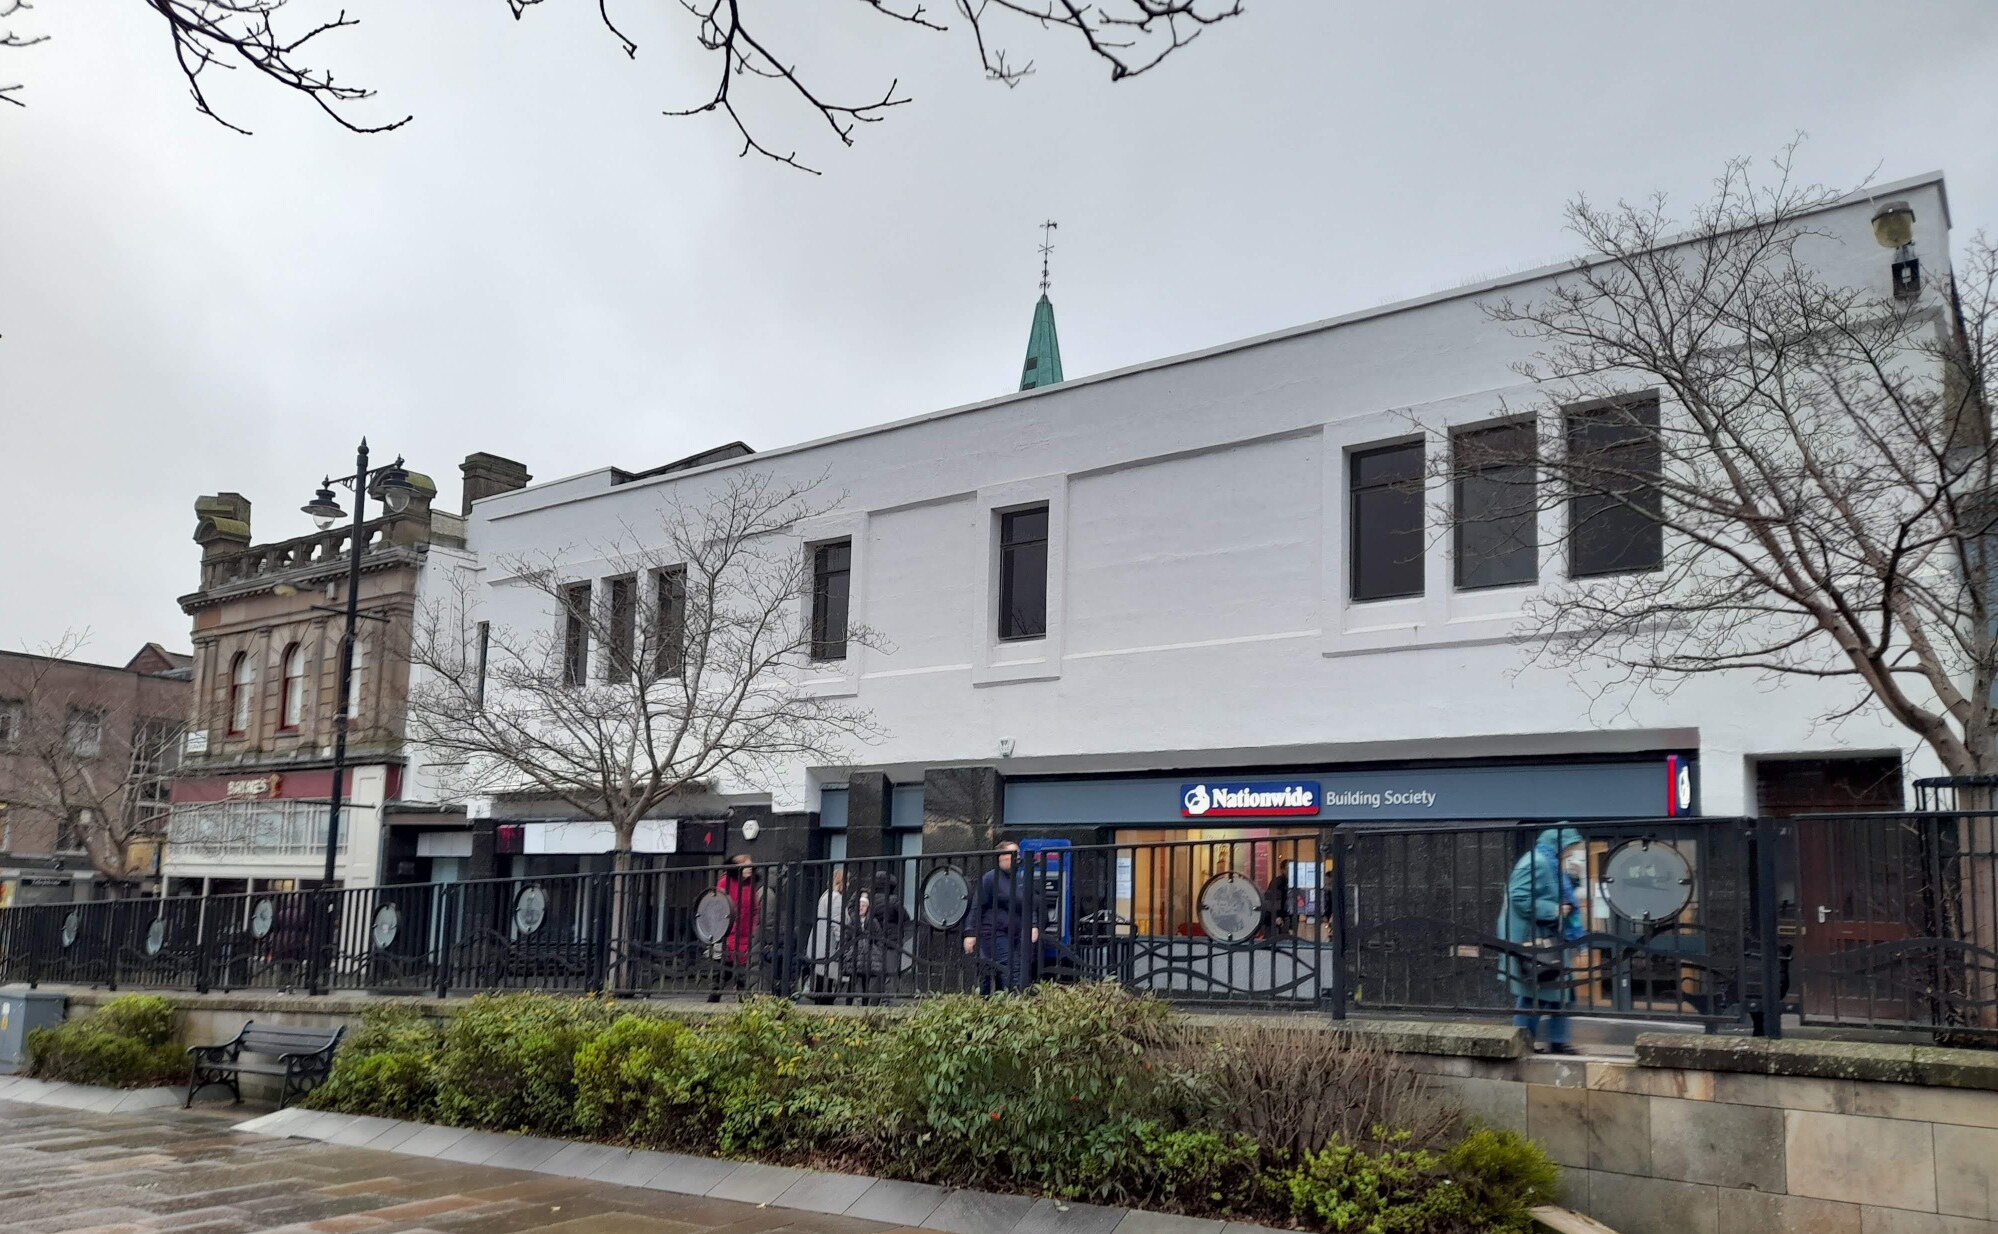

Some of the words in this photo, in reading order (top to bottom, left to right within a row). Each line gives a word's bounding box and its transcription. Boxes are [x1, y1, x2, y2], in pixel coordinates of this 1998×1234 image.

[1212, 787, 1313, 809] Nationwide
[1326, 790, 1380, 808] Building
[1384, 789, 1436, 807] Society
